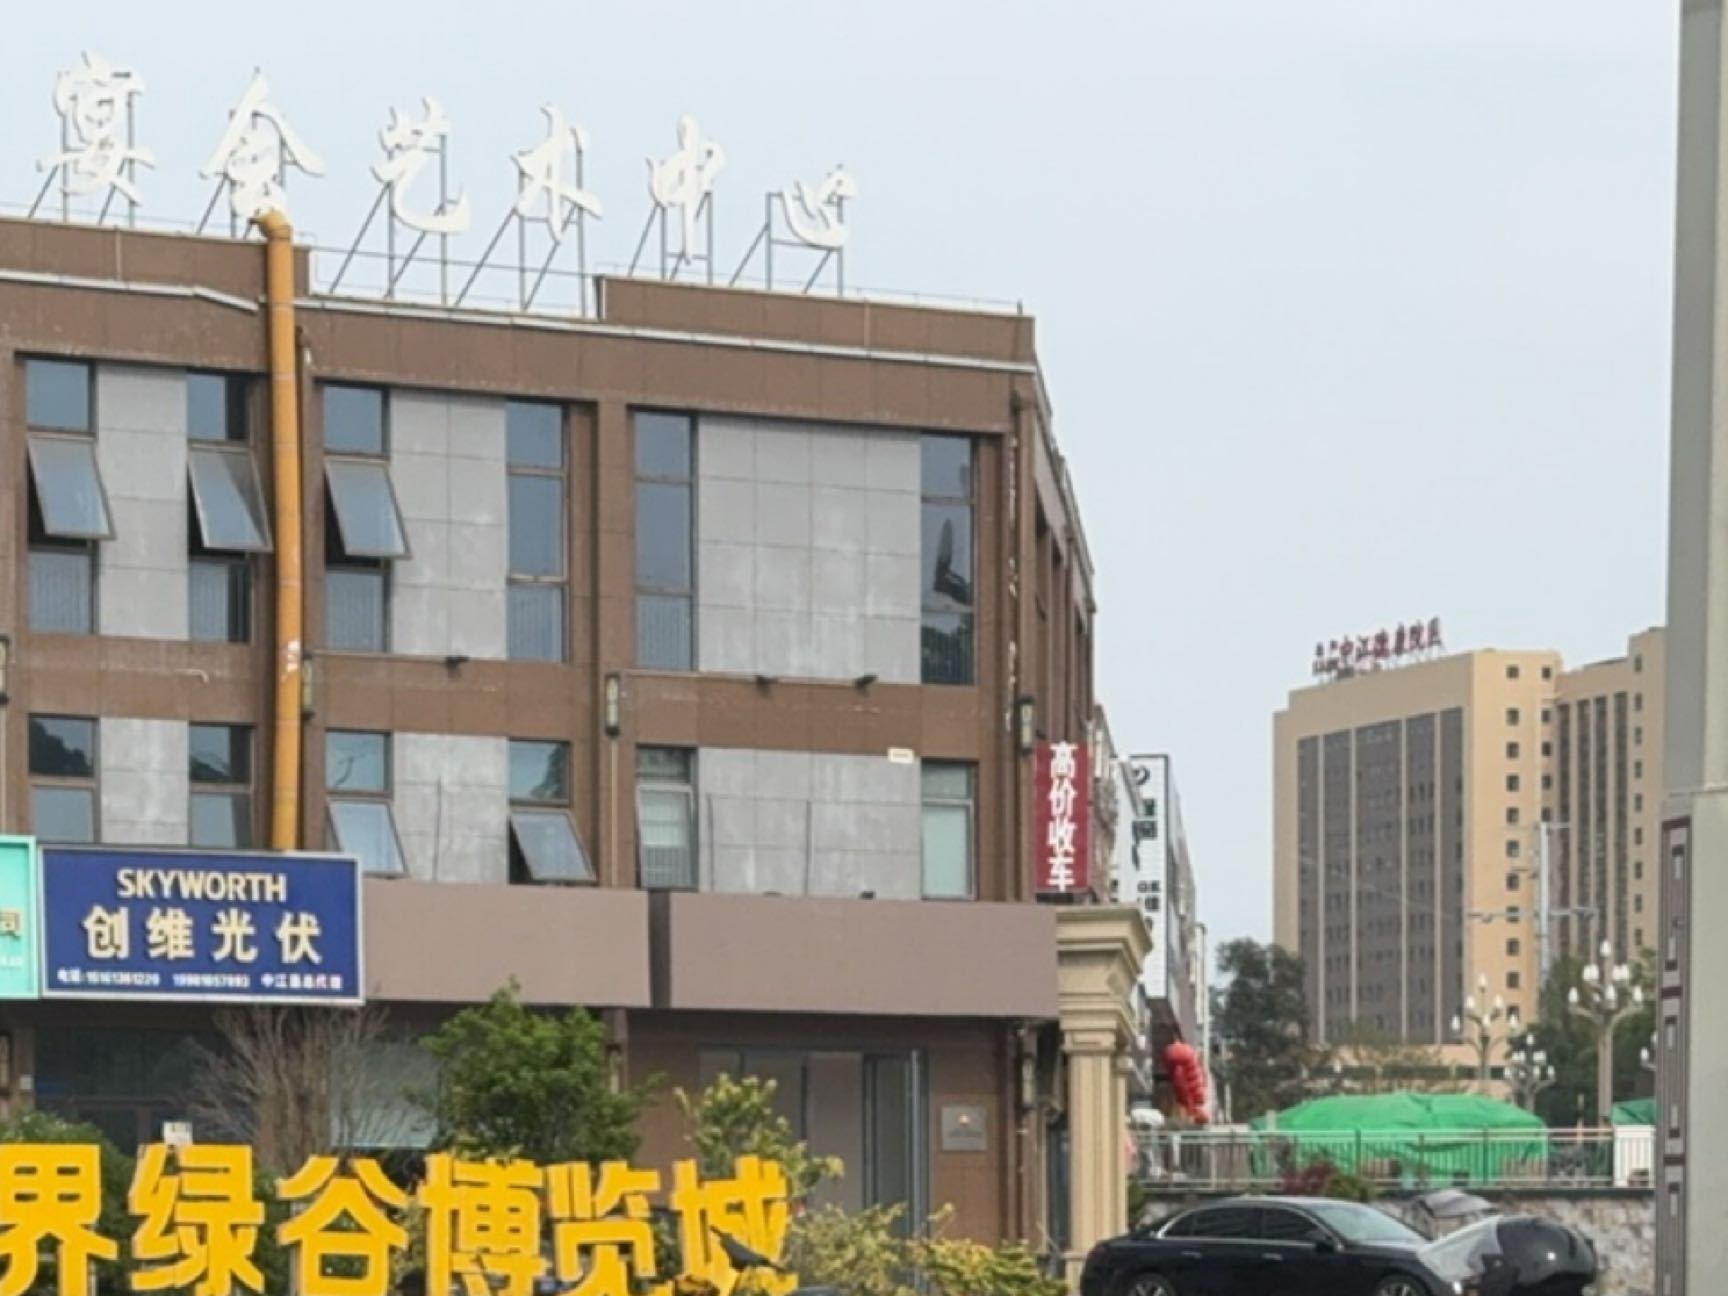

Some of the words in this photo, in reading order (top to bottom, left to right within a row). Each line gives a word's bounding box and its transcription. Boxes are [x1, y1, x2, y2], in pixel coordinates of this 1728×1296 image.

[1046, 740, 1079, 893] 高价收车
[117, 867, 288, 903] SKYWORTH
[81, 904, 323, 965] 创维光伏
